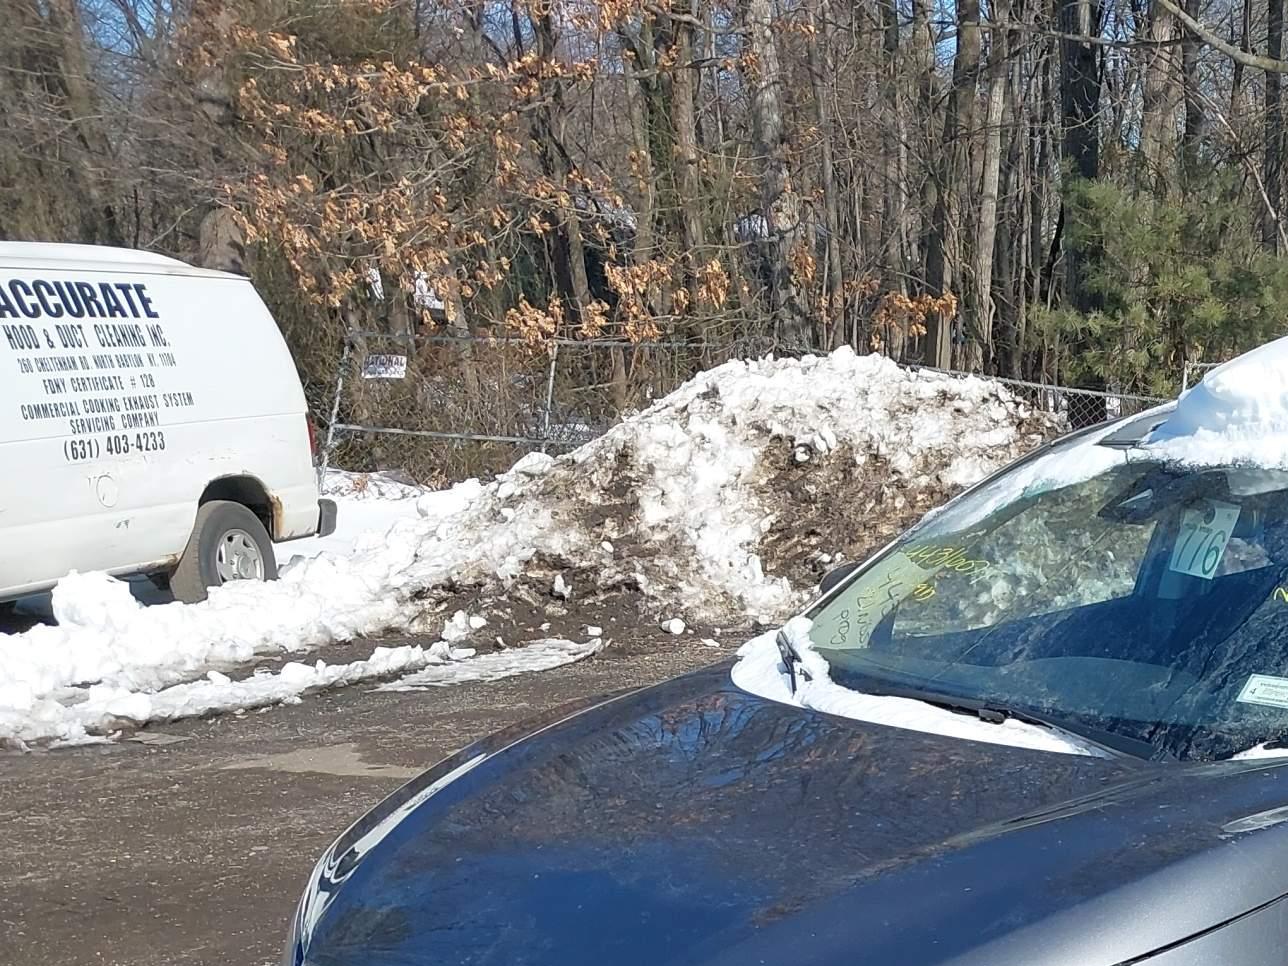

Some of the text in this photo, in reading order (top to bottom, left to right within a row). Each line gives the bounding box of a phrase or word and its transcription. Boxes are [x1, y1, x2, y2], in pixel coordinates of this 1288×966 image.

[0, 279, 160, 318] ACCURATE
[3, 324, 171, 350] HOOD & DUCT CLEANING INC.
[34, 356, 79, 373] CHELTENHAM
[92, 354, 115, 369] NORTH
[115, 353, 145, 369] BABYLON
[42, 373, 156, 395] FDNY CERTIFICATE # 128
[20, 391, 195, 420] COMMERCIAL COOKING EXHAUST SYSTEM
[69, 411, 160, 434] SERVICING COMPANY
[64, 431, 166, 461] (631) 403-4233
[1175, 523, 1226, 576] 776
